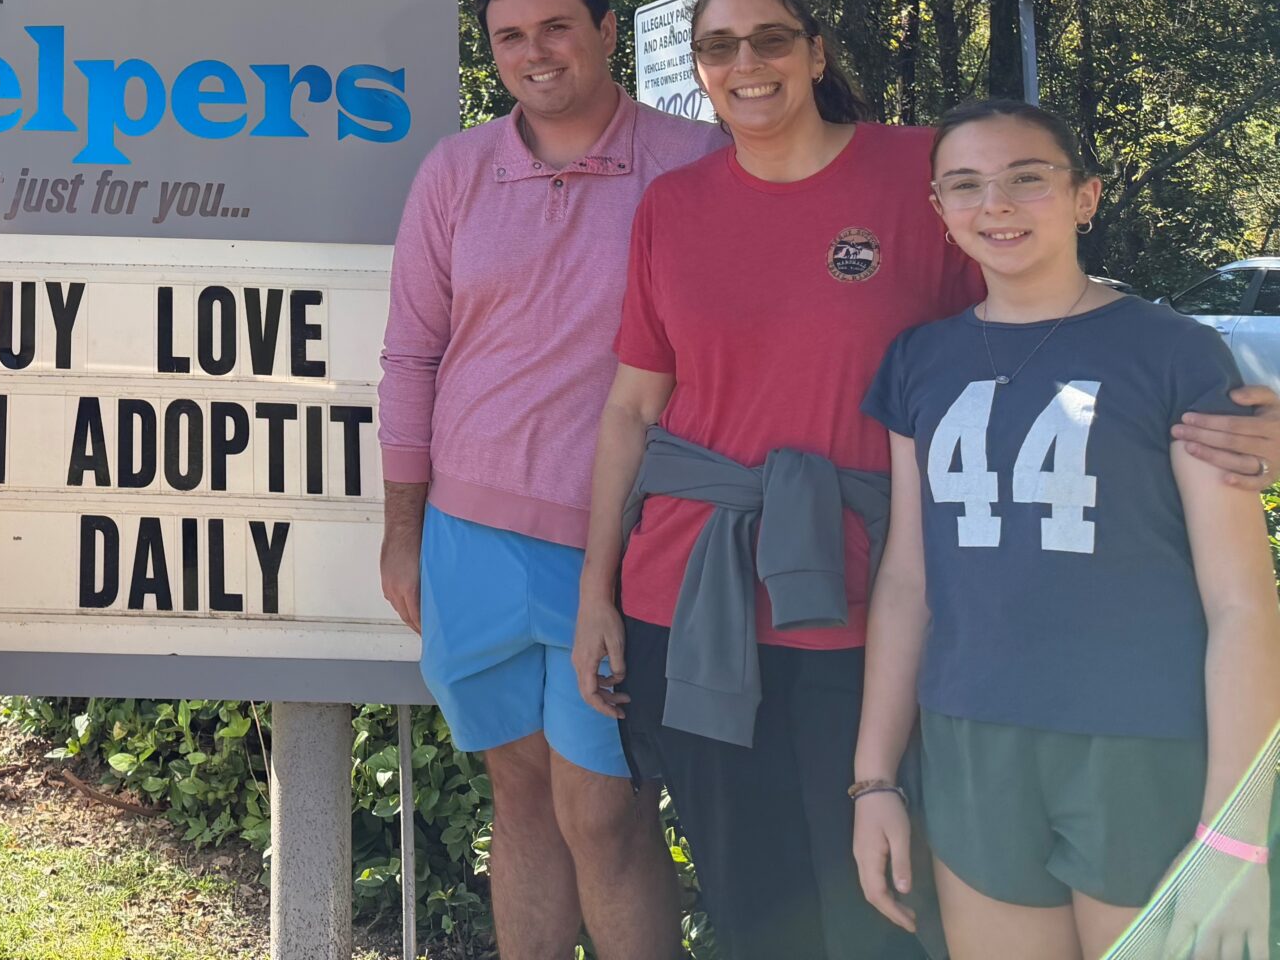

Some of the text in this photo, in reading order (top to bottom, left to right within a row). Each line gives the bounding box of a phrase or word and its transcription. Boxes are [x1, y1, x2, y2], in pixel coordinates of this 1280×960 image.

[641, 10, 675, 35] ILLEGALLY
[643, 39, 658, 55] AND
[644, 60, 666, 75] VEHICLES
[666, 57, 679, 70] WILL
[650, 77, 660, 89] THE
[660, 71, 683, 87] OWNER'S
[4, 167, 85, 221] just
[91, 169, 149, 215] for
[152, 179, 251, 225] you...
[157, 285, 327, 378] LOVE
[927, 379, 1102, 554] 44
[78, 514, 291, 615] DAILY
